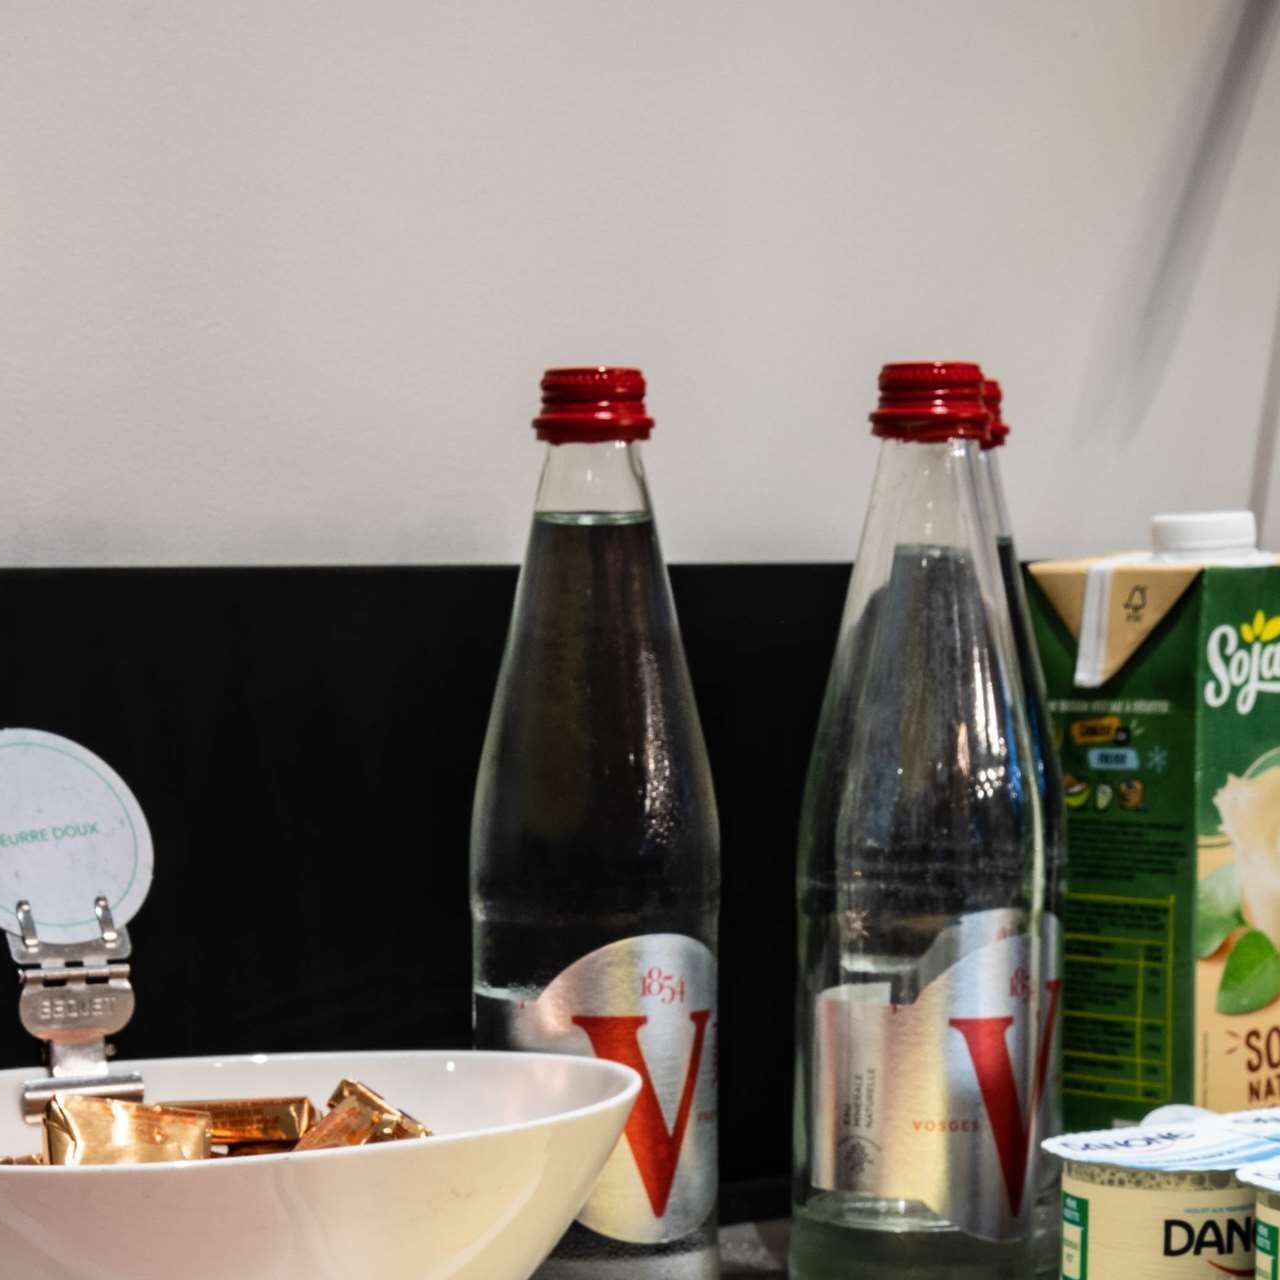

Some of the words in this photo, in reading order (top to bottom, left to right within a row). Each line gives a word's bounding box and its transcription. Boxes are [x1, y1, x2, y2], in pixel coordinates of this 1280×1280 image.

[53, 822, 100, 842] DOUX
[640, 966, 688, 1006] 1854
[571, 1008, 712, 1219] V
[1163, 1215, 1256, 1257] DAN
